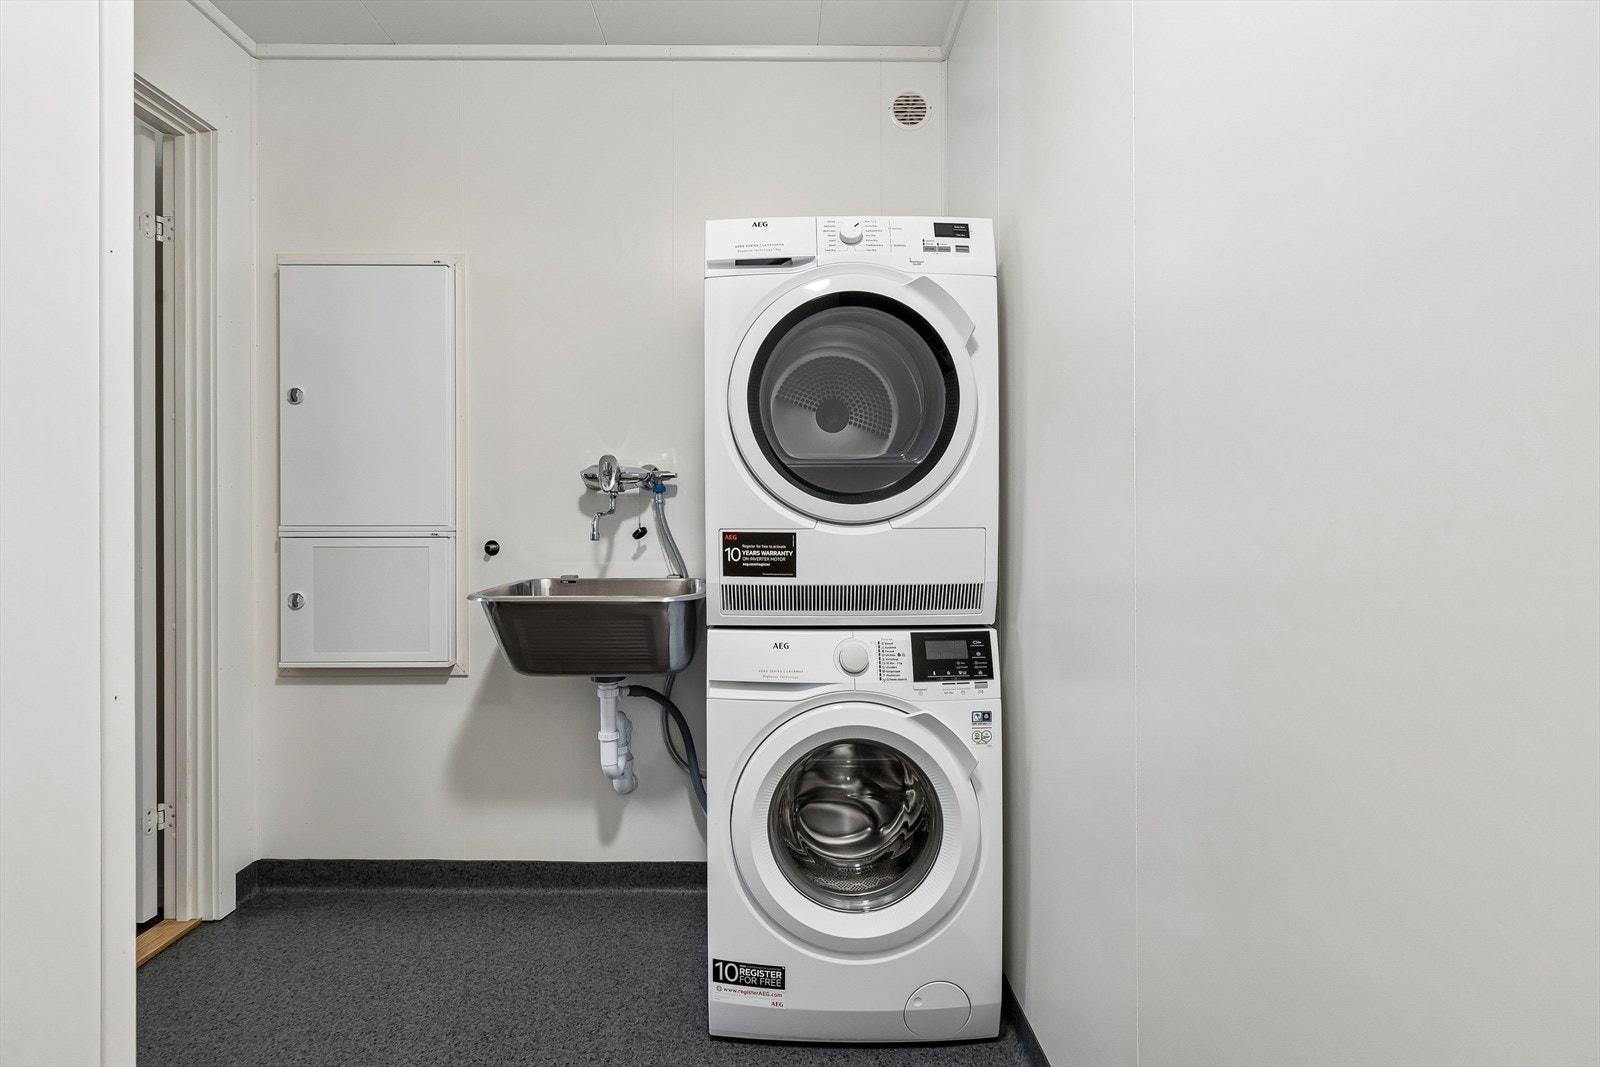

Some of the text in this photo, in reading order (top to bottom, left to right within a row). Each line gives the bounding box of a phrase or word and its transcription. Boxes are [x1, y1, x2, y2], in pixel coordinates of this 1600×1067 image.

[724, 547, 742, 562] 10
[772, 642, 790, 650] AEG
[714, 962, 739, 982] 10
[739, 968, 782, 979] REGISTER
[739, 976, 782, 987] FOR FREE
[723, 987, 783, 998] www.registerAEG.com
